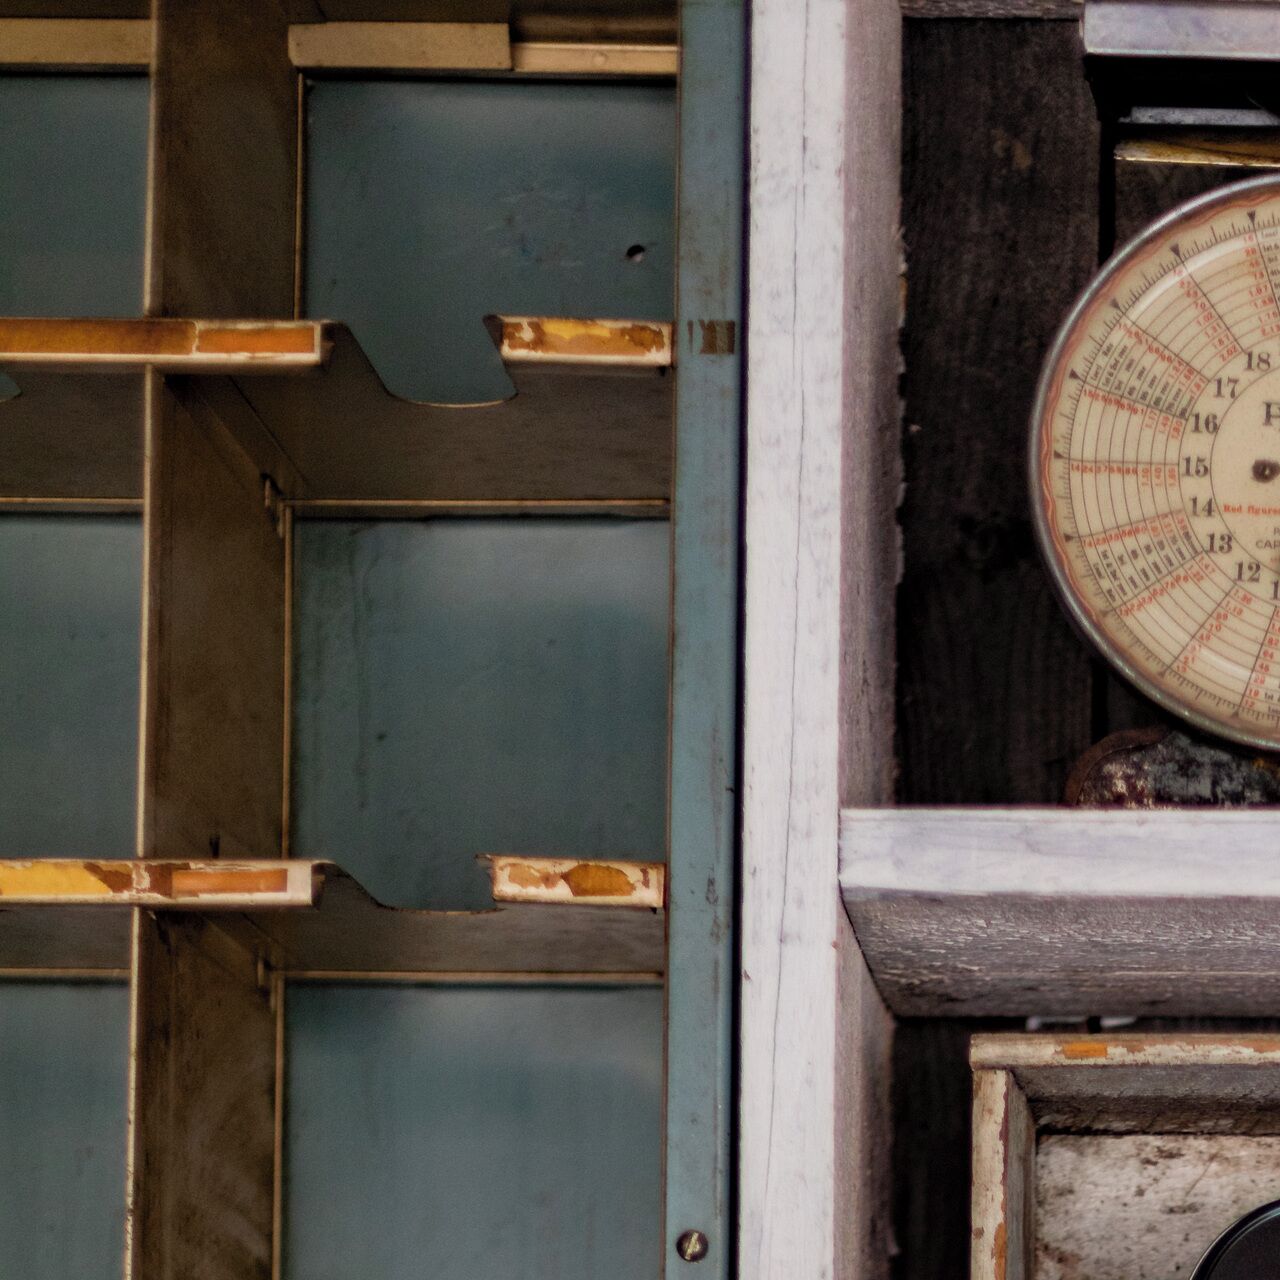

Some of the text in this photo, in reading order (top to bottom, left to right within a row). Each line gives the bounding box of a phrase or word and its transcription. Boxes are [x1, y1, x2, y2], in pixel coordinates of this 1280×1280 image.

[1244, 351, 1271, 372] 18
[1214, 376, 1239, 399] 17
[1191, 412, 1218, 434] 16
[1182, 456, 1208, 477] 15
[1189, 496, 1214, 517] 14
[1223, 504, 1242, 513] Red
[1206, 532, 1232, 554] 13
[1234, 561, 1261, 582] 12
